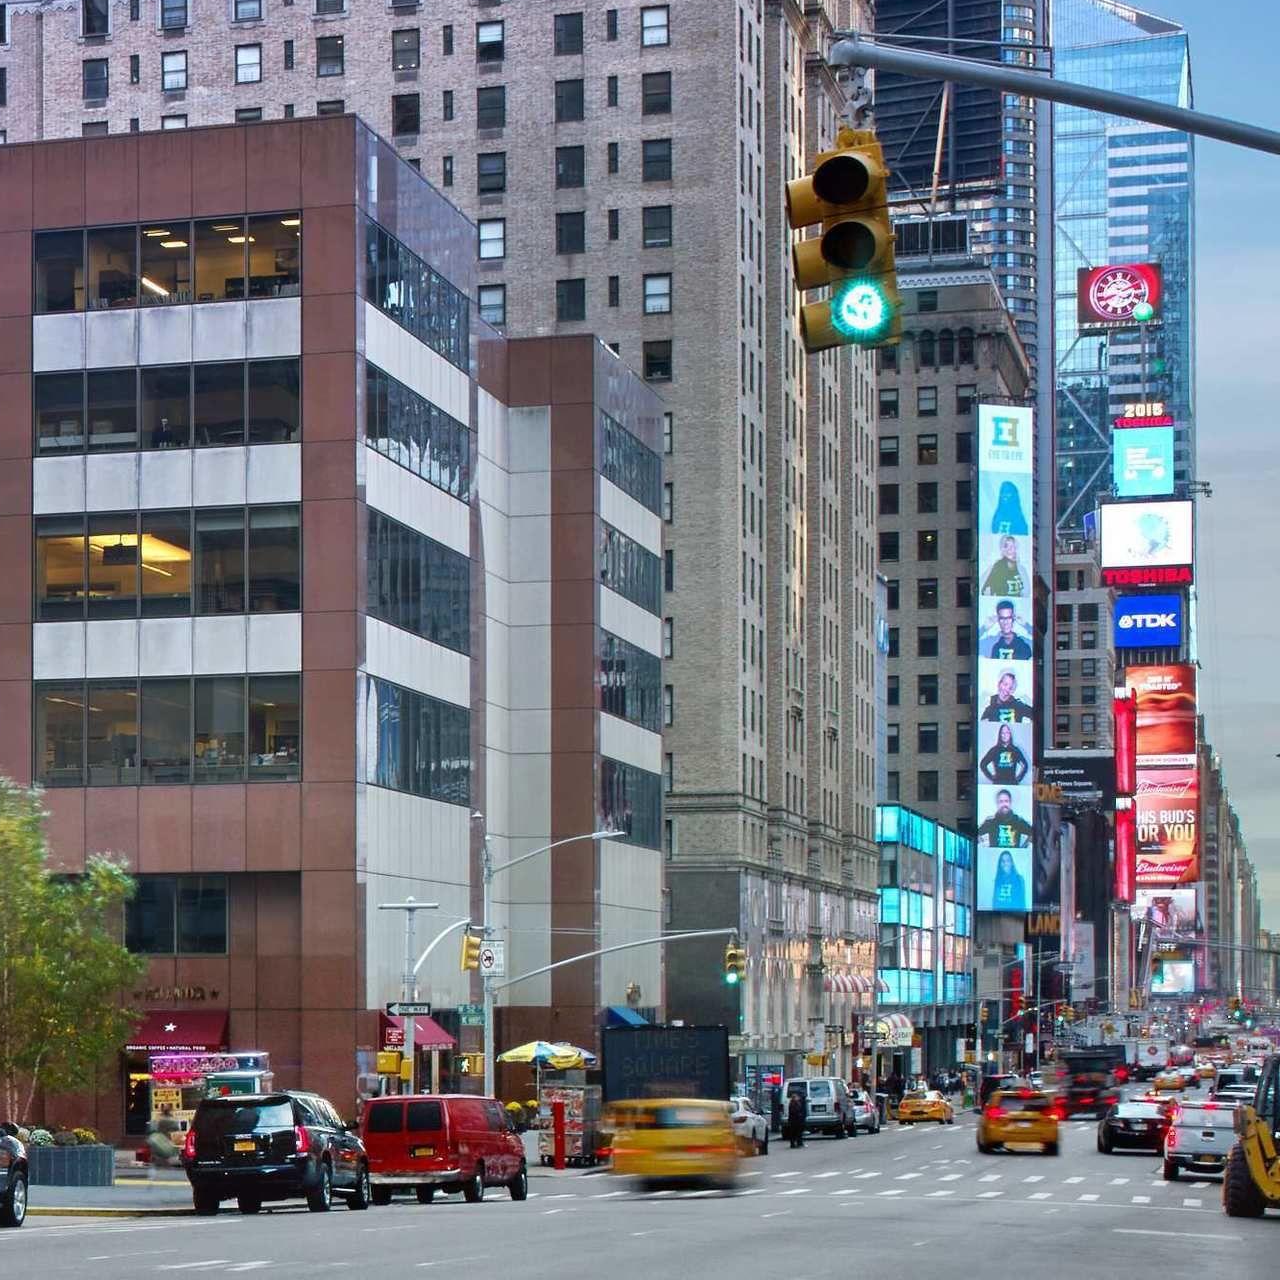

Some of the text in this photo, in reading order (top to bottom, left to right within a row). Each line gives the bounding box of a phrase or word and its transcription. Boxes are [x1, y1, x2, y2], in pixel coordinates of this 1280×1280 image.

[1124, 403, 1163, 418] 2015
[1104, 568, 1191, 584] TOSHIBA
[1133, 613, 1176, 628] TDK
[1136, 809, 1195, 824] HIS BUD'S
[1136, 824, 1195, 842] OR YOU
[1136, 862, 1188, 874] Budweiser
